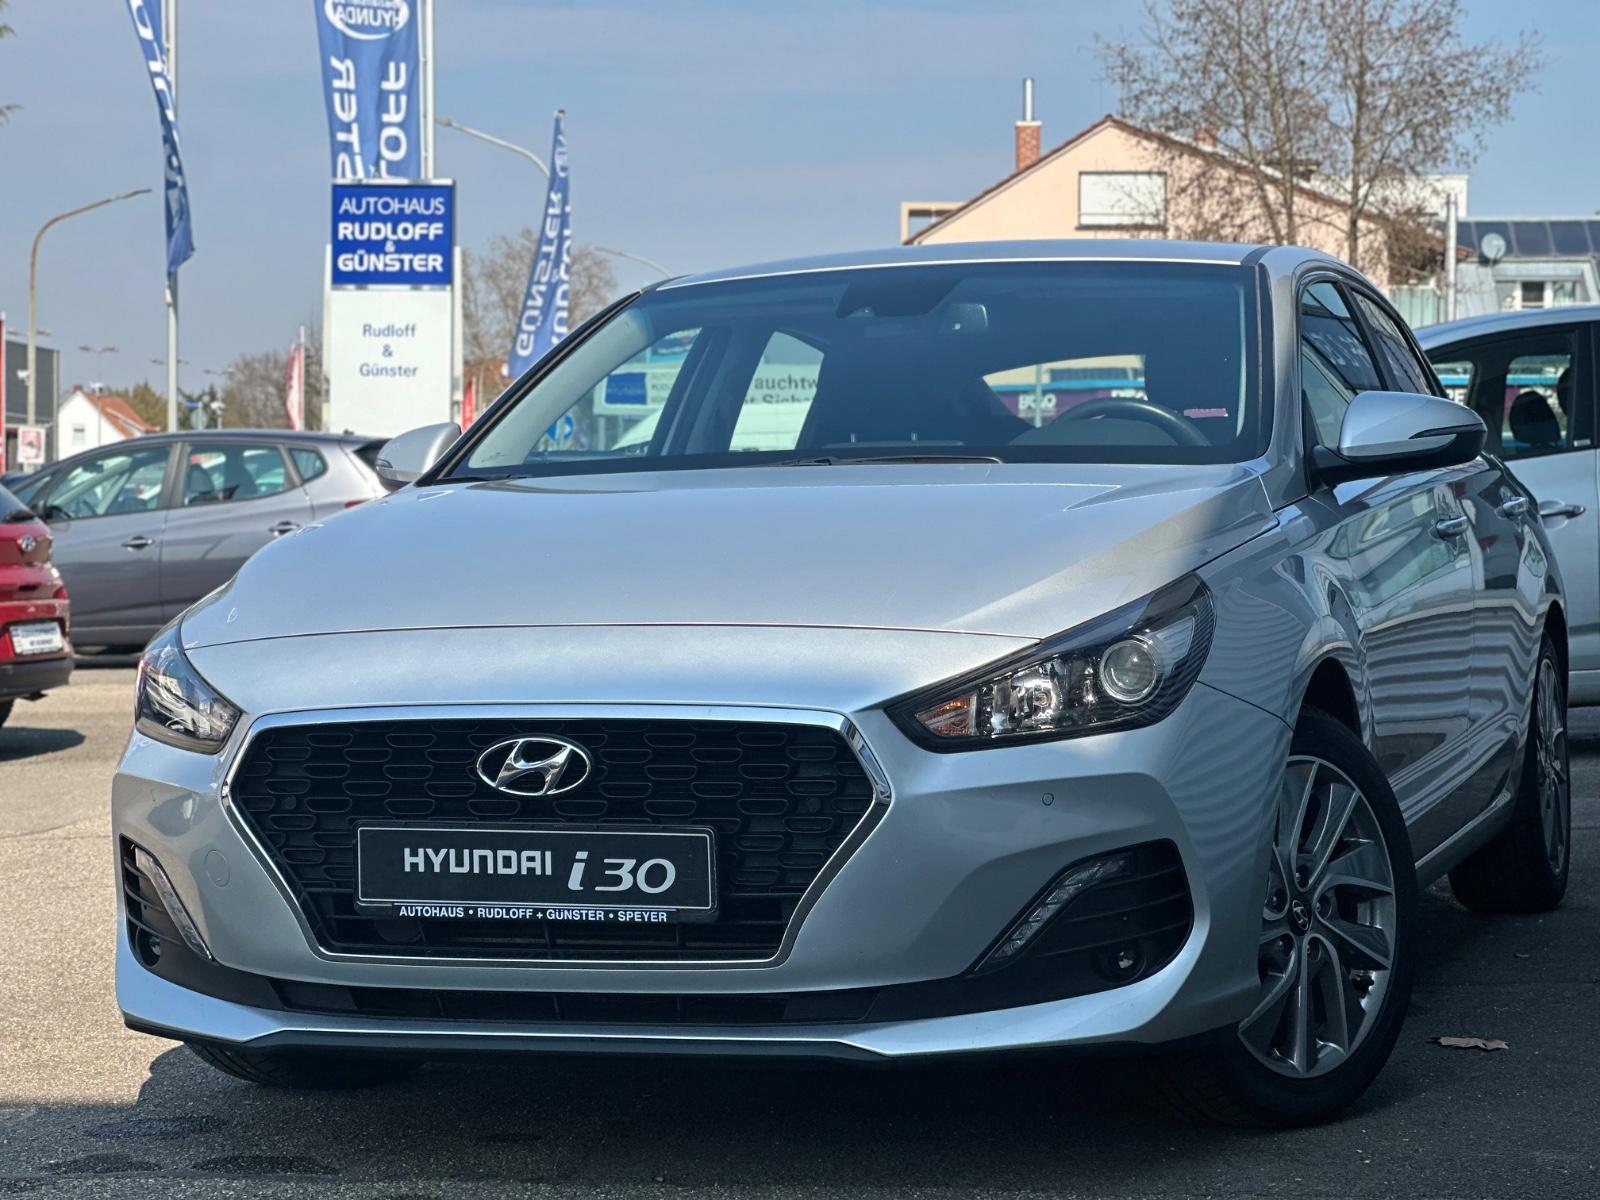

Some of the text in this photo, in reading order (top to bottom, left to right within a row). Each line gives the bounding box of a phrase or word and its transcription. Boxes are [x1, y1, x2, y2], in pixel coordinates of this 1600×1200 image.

[339, 196, 445, 215] AUTOHAUS
[338, 221, 444, 241] RUDLOFF
[384, 240, 396, 253] &
[337, 249, 444, 273] GÜNSTER
[362, 323, 417, 338] Rudloff
[381, 344, 393, 358] &
[359, 362, 418, 378] Günster
[404, 847, 677, 894] HYUNDAI i 30
[399, 904, 465, 918] AUTOHAUS
[477, 906, 534, 920] RUDLOFF
[546, 907, 605, 921] GÜNSTER
[617, 909, 667, 923] SPEYER
